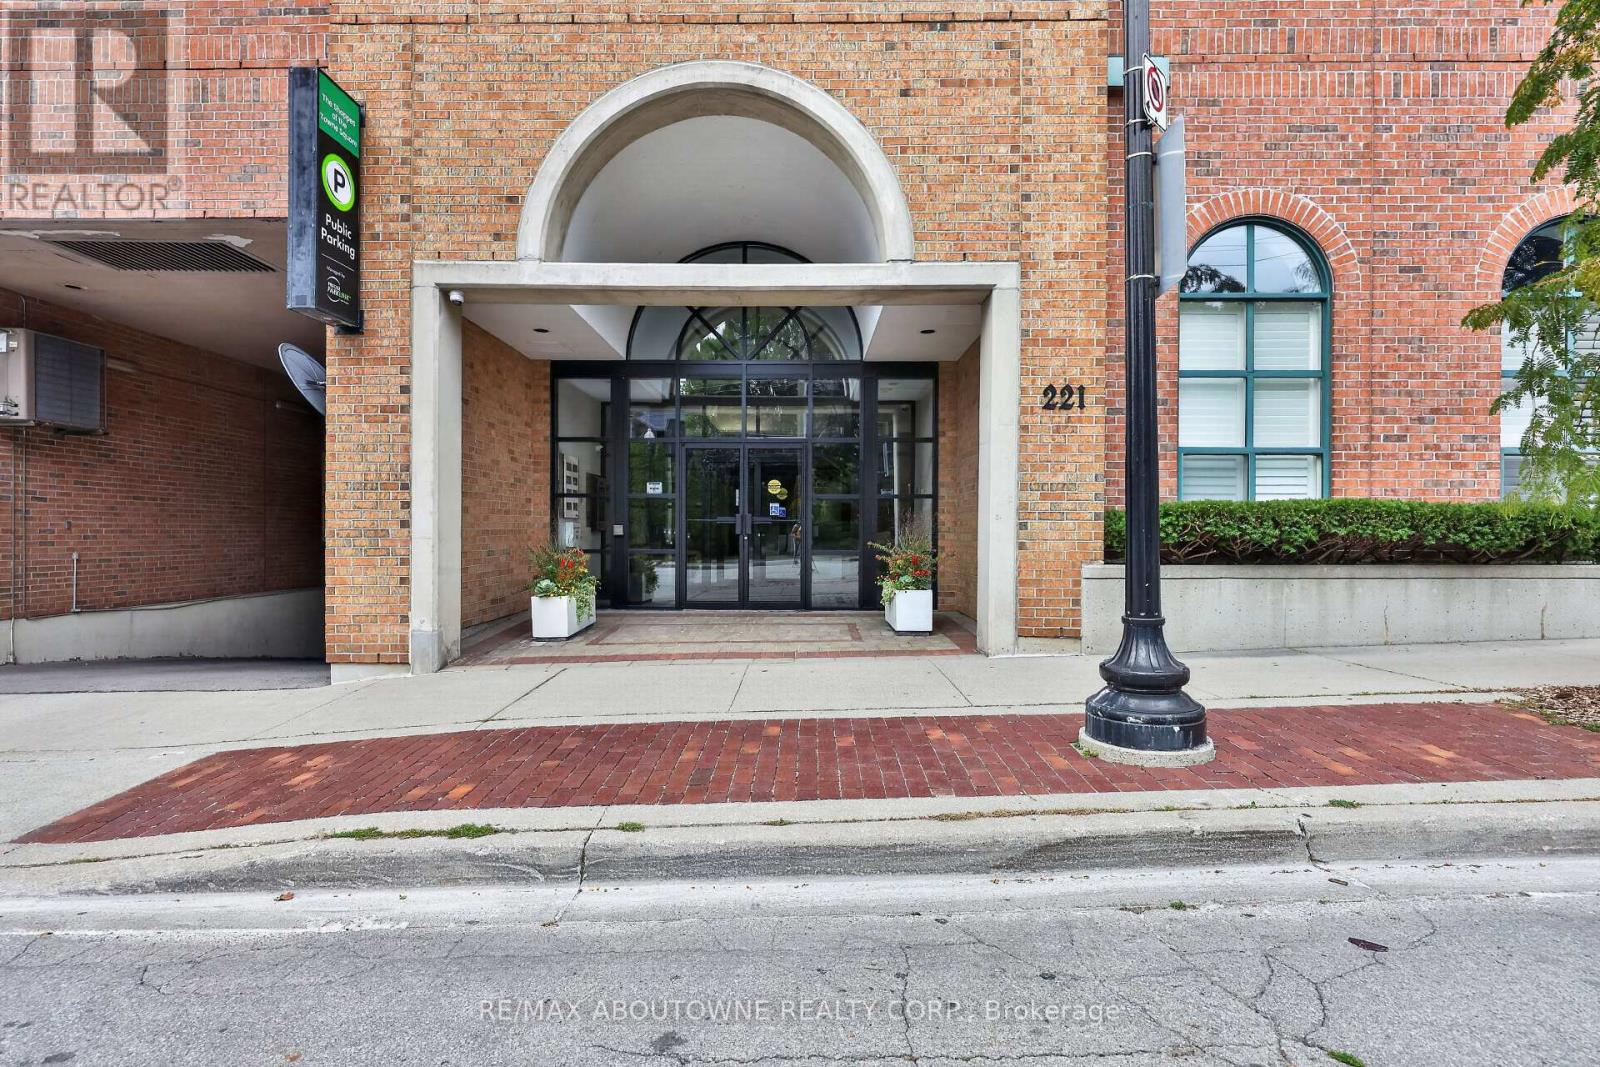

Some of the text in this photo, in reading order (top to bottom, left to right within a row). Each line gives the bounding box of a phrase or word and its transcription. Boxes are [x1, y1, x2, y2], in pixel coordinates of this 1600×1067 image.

[321, 93, 333, 108] The
[332, 112, 348, 129] of the
[339, 127, 358, 148] Square
[334, 168, 346, 193] P
[325, 212, 352, 240] Public
[321, 226, 356, 260] Parking
[1042, 383, 1086, 410] 221
